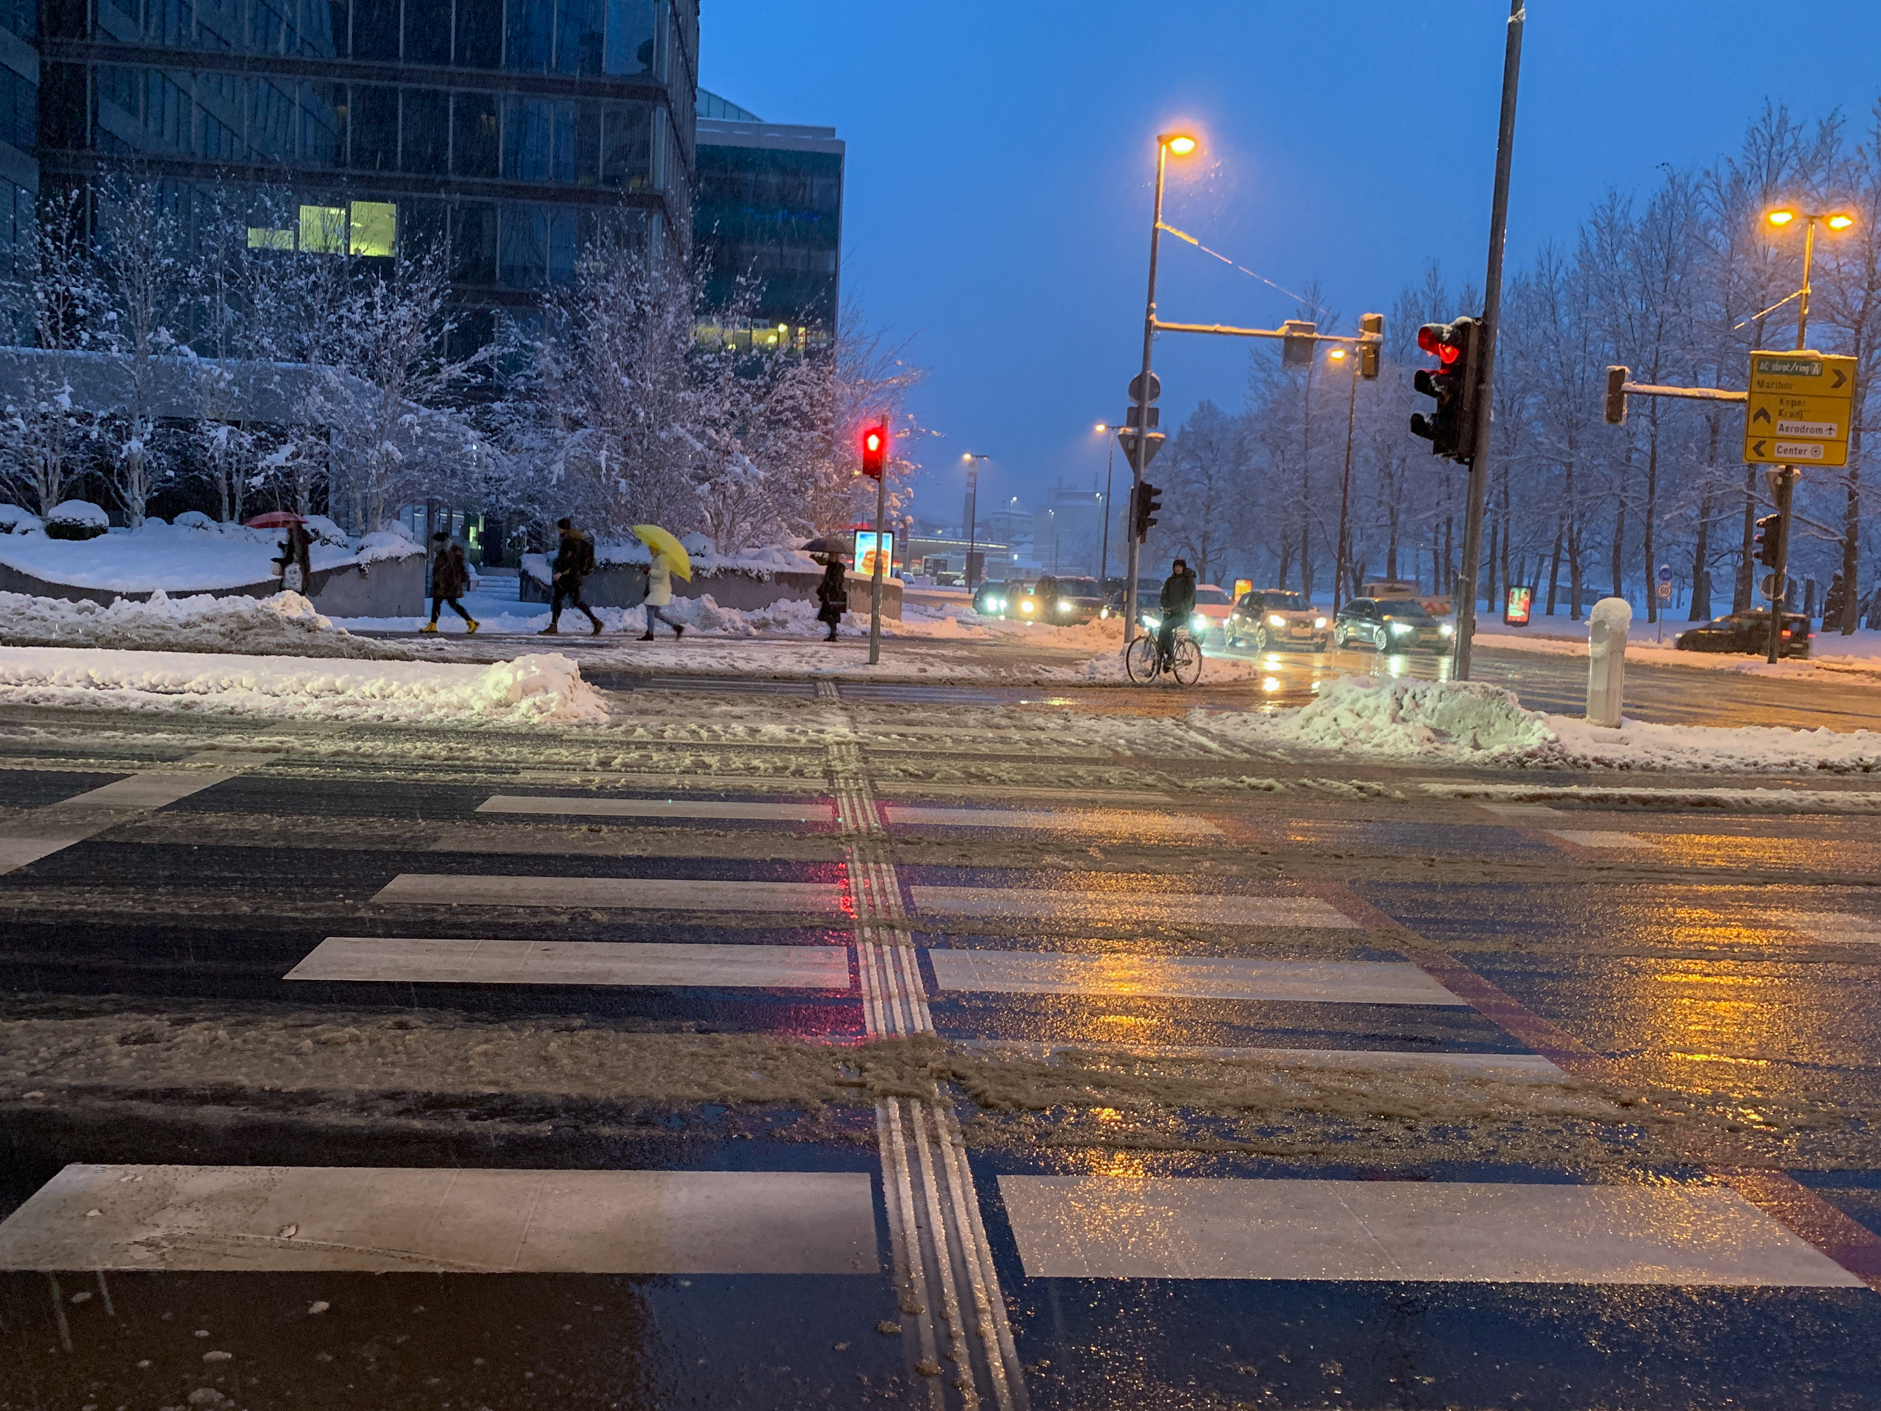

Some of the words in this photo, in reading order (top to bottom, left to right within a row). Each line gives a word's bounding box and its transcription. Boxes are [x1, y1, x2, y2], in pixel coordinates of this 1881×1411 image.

[1759, 362, 1769, 370] AC
[1756, 380, 1794, 390] Maribor
[1779, 397, 1806, 408] Koper
[1778, 409, 1804, 421] Kranj
[1778, 423, 1823, 434] Aerodrom
[1776, 445, 1808, 456] Center
[1660, 586, 1669, 594] 60
